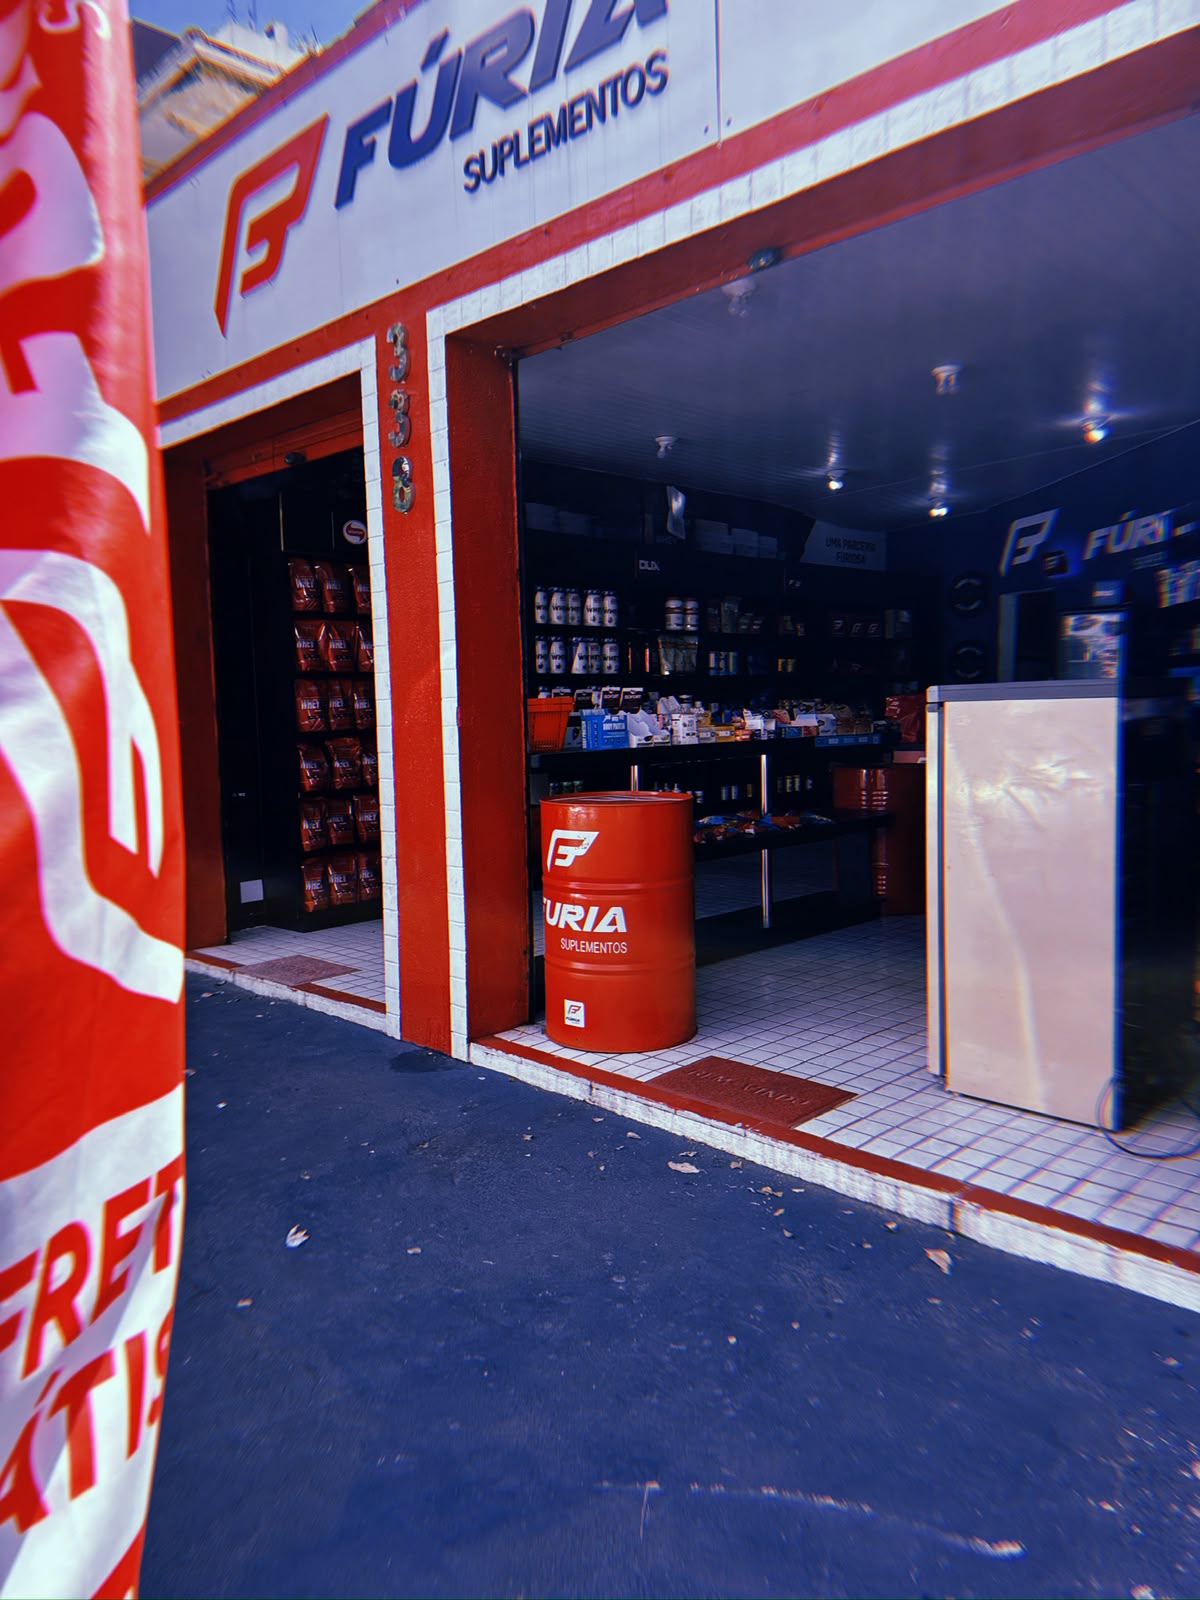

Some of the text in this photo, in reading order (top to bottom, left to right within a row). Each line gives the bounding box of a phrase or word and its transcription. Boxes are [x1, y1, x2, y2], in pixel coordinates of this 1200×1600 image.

[463, 48, 669, 193] SUPLEMENTOS
[543, 897, 628, 933] URIA
[560, 938, 628, 954] SUPLEMENTOS
